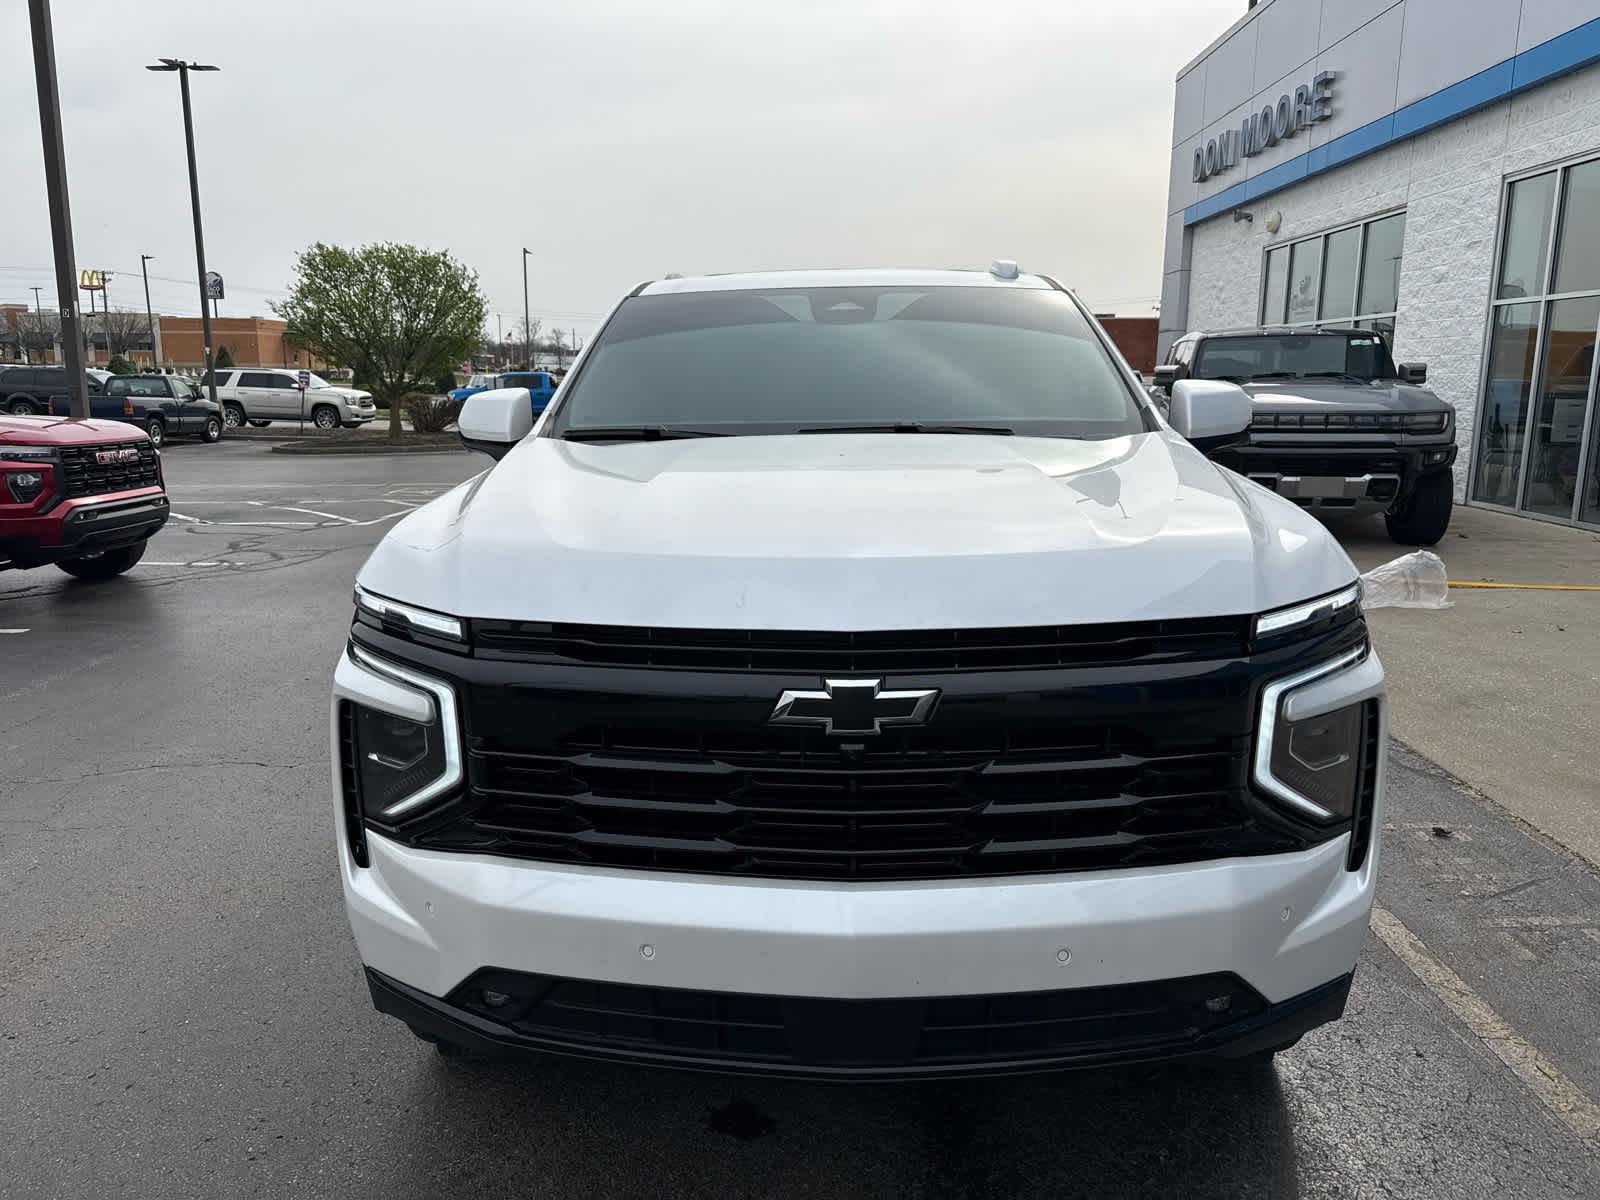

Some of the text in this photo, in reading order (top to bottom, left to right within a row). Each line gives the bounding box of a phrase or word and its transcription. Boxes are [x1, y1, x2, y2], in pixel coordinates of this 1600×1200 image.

[1192, 70, 1336, 183] DON MOORE
[96, 449, 138, 464] GMC
